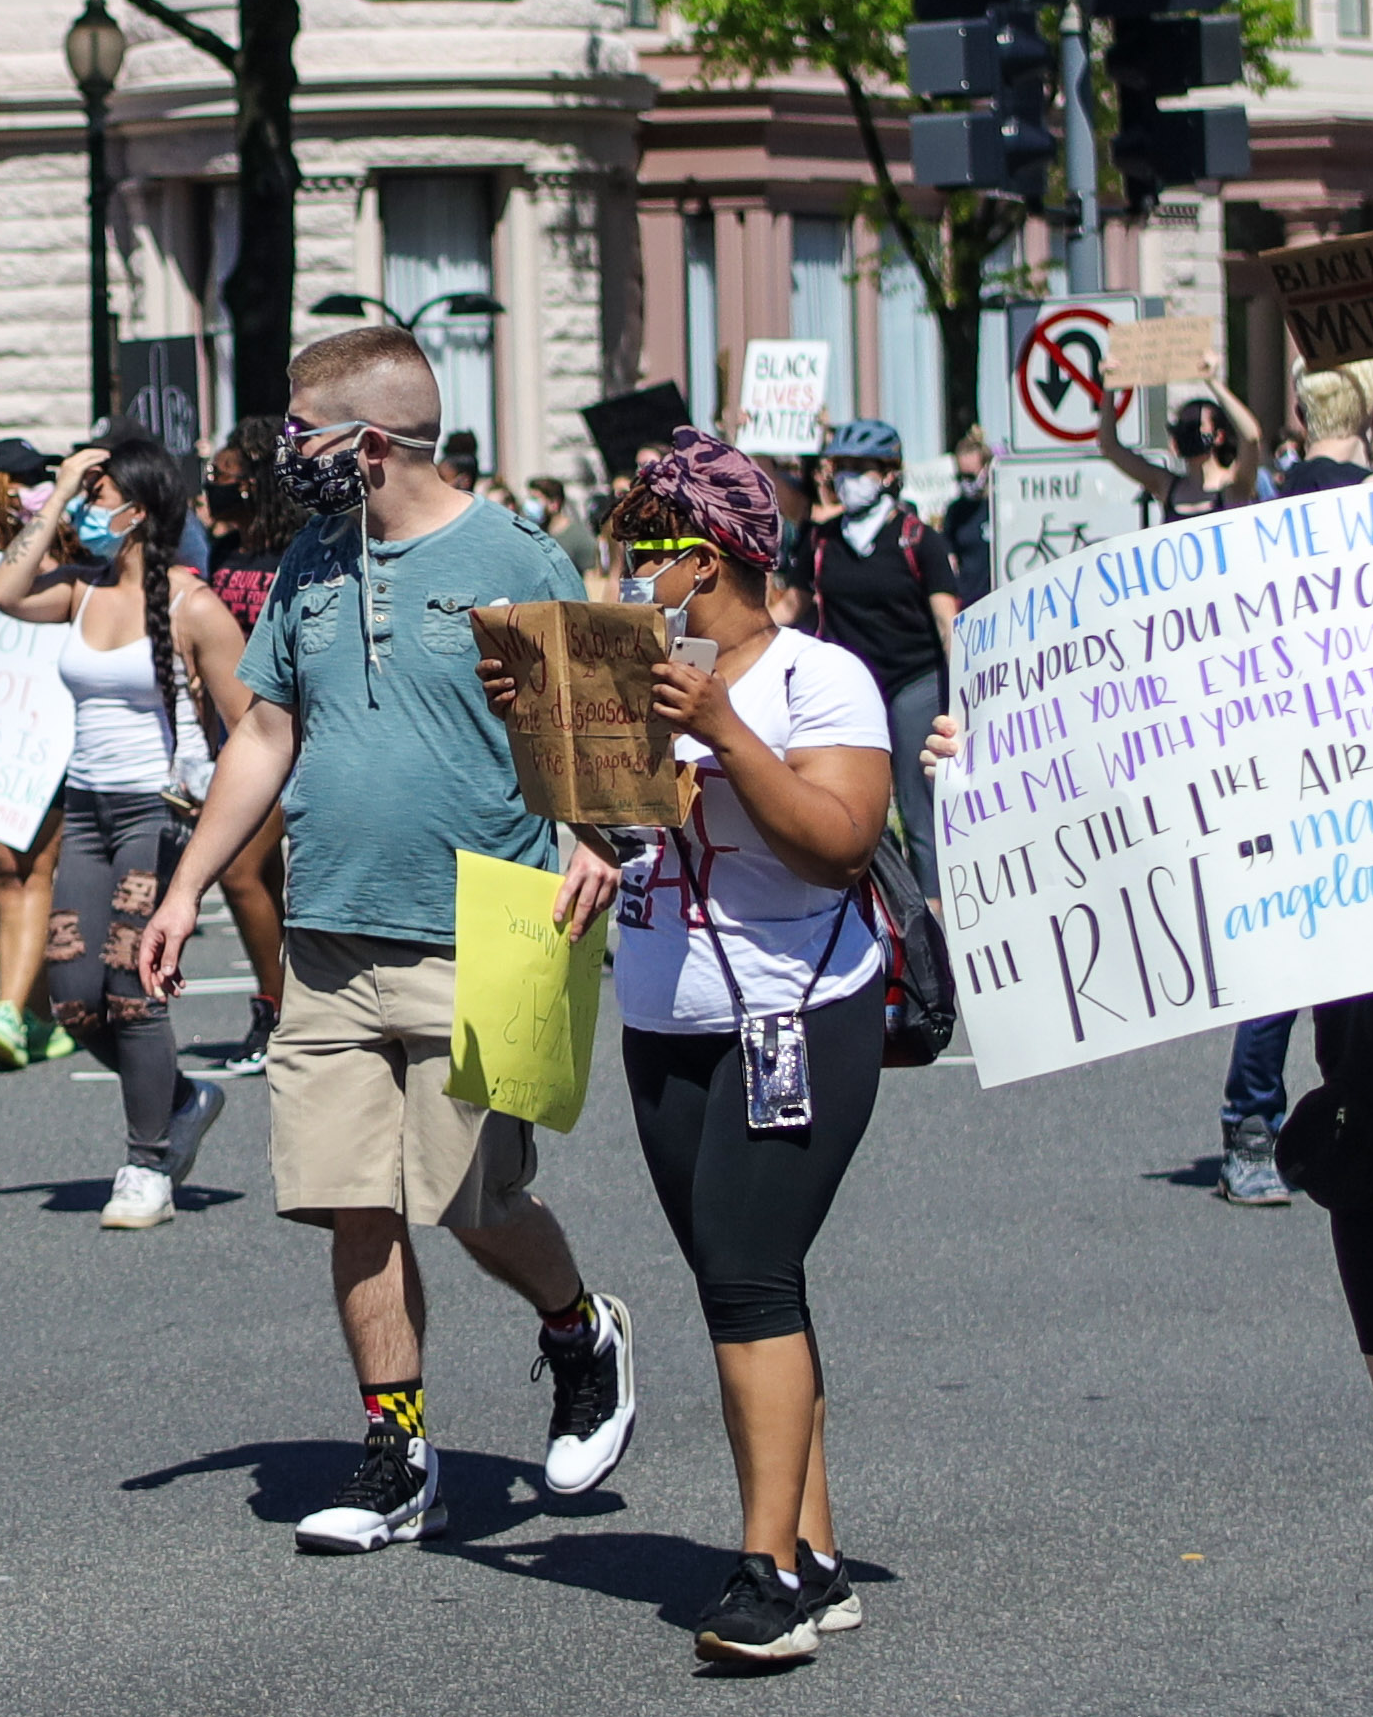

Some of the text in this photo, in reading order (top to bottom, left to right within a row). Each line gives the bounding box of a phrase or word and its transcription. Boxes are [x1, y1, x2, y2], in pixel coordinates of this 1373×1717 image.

[1272, 249, 1364, 294] BLACK
[752, 383, 814, 409] LIVES
[755, 353, 818, 380] BLACK
[743, 408, 818, 441] MATTER
[1019, 470, 1082, 499] THRU
[1009, 566, 1083, 648] MAY
[1095, 521, 1234, 606] SHOOT
[1254, 502, 1329, 563] ME
[472, 604, 548, 695] Why
[959, 662, 1010, 732] YOUR
[1133, 602, 1221, 664] YOU
[1234, 567, 1342, 634] MAY
[988, 697, 1068, 765] WITH
[1080, 674, 1177, 723] YOUR
[941, 781, 1013, 846] KILL
[1021, 749, 1088, 813] ME
[1097, 715, 1195, 789] WITH
[1200, 689, 1297, 747] YOUR
[948, 841, 1036, 930] BUT
[1188, 755, 1269, 836] LIKE
[504, 904, 562, 959] MATTER
